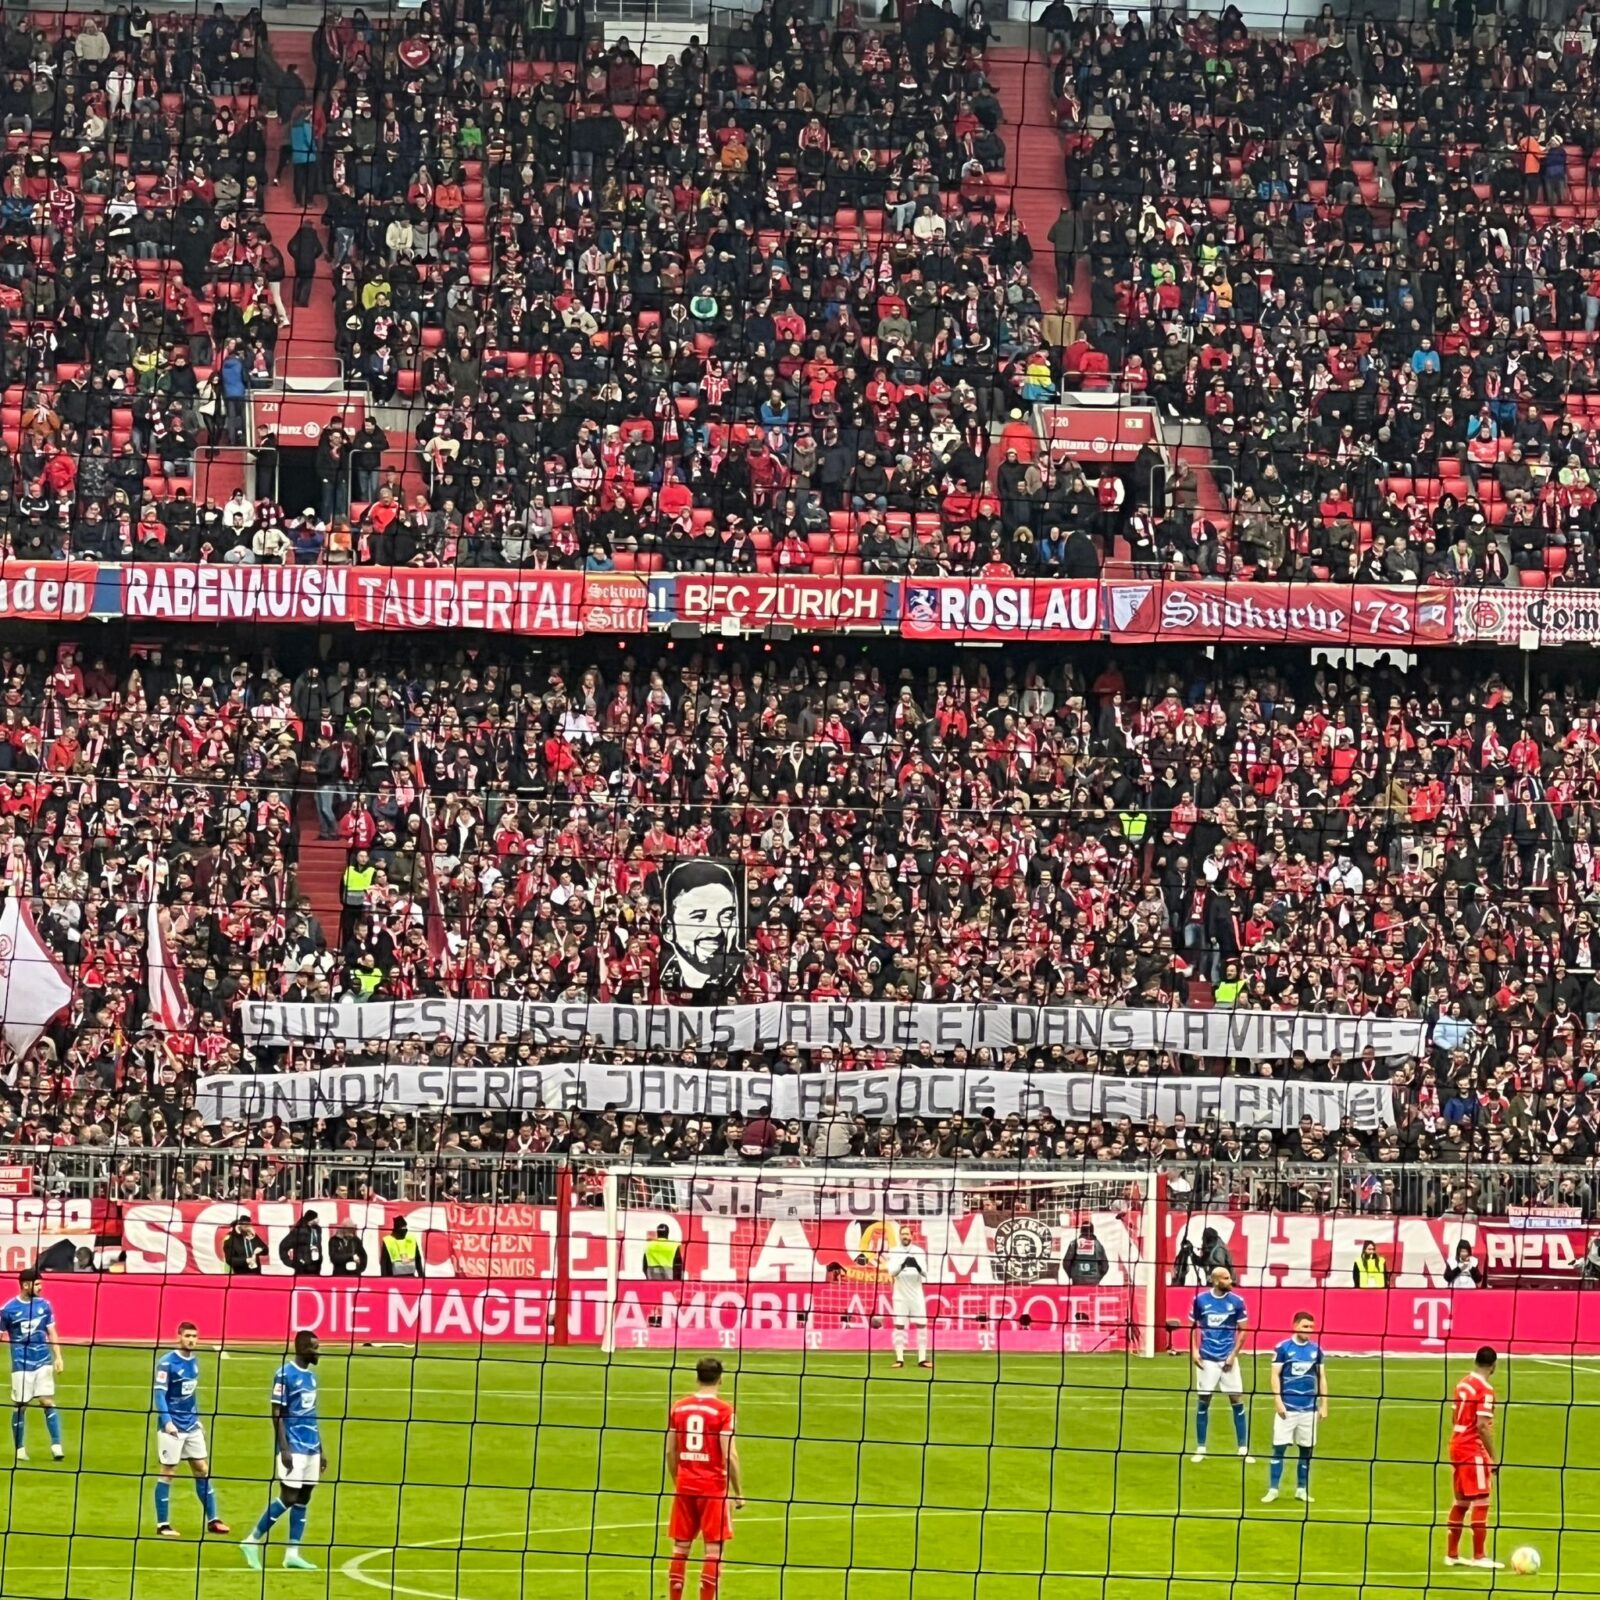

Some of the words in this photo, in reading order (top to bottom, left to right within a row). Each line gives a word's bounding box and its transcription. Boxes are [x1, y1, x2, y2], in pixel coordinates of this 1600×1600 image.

[126, 568, 347, 618] RABENAU/SN
[358, 576, 582, 632] TAUBERTAL
[588, 583, 646, 598] Sektion
[684, 584, 751, 616] BFC
[759, 582, 878, 621] ZÜRICH
[941, 583, 1097, 631] RÖSLAU
[1161, 590, 1345, 633] Südkurve
[248, 1004, 341, 1041] SUR
[357, 1000, 447, 1039] LES
[612, 1006, 735, 1050] DANS
[755, 1004, 813, 1044] LA
[827, 1004, 918, 1044] RUE
[936, 1005, 998, 1045] ET
[1011, 1007, 1134, 1048] DANS
[1152, 1011, 1209, 1051] LA
[205, 1078, 299, 1119] TON
[308, 1071, 400, 1116] NOM
[417, 1069, 543, 1109] SERA
[606, 1070, 772, 1116] JAMAIS
[801, 1076, 996, 1115] ASSOCIÉ
[1067, 1077, 1220, 1125] CETTE
[291, 1288, 371, 1332] DIE
[686, 1414, 704, 1452] 8
